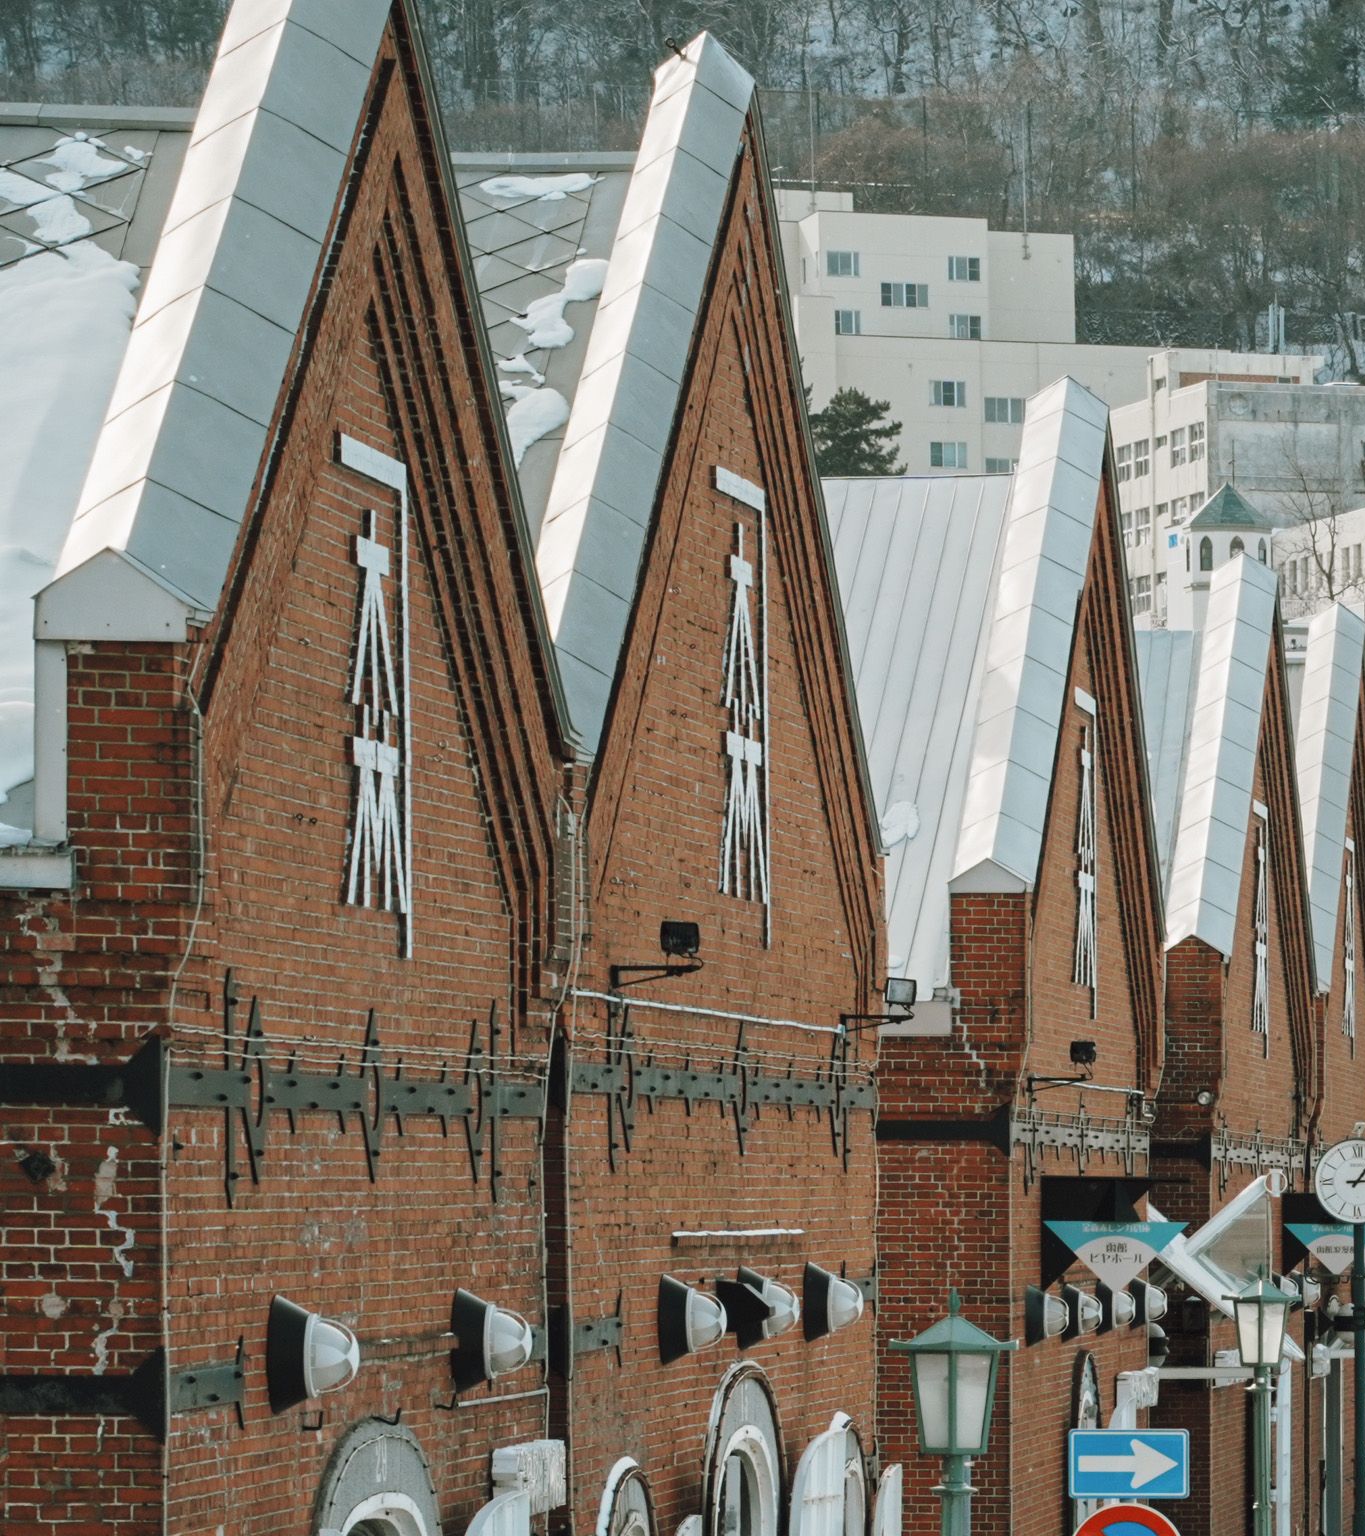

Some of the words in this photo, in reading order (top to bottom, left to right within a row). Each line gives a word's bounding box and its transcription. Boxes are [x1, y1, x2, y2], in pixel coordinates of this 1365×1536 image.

[1106, 1243, 1128, 1253] 函館
[1090, 1253, 1144, 1264] ビヤホール
